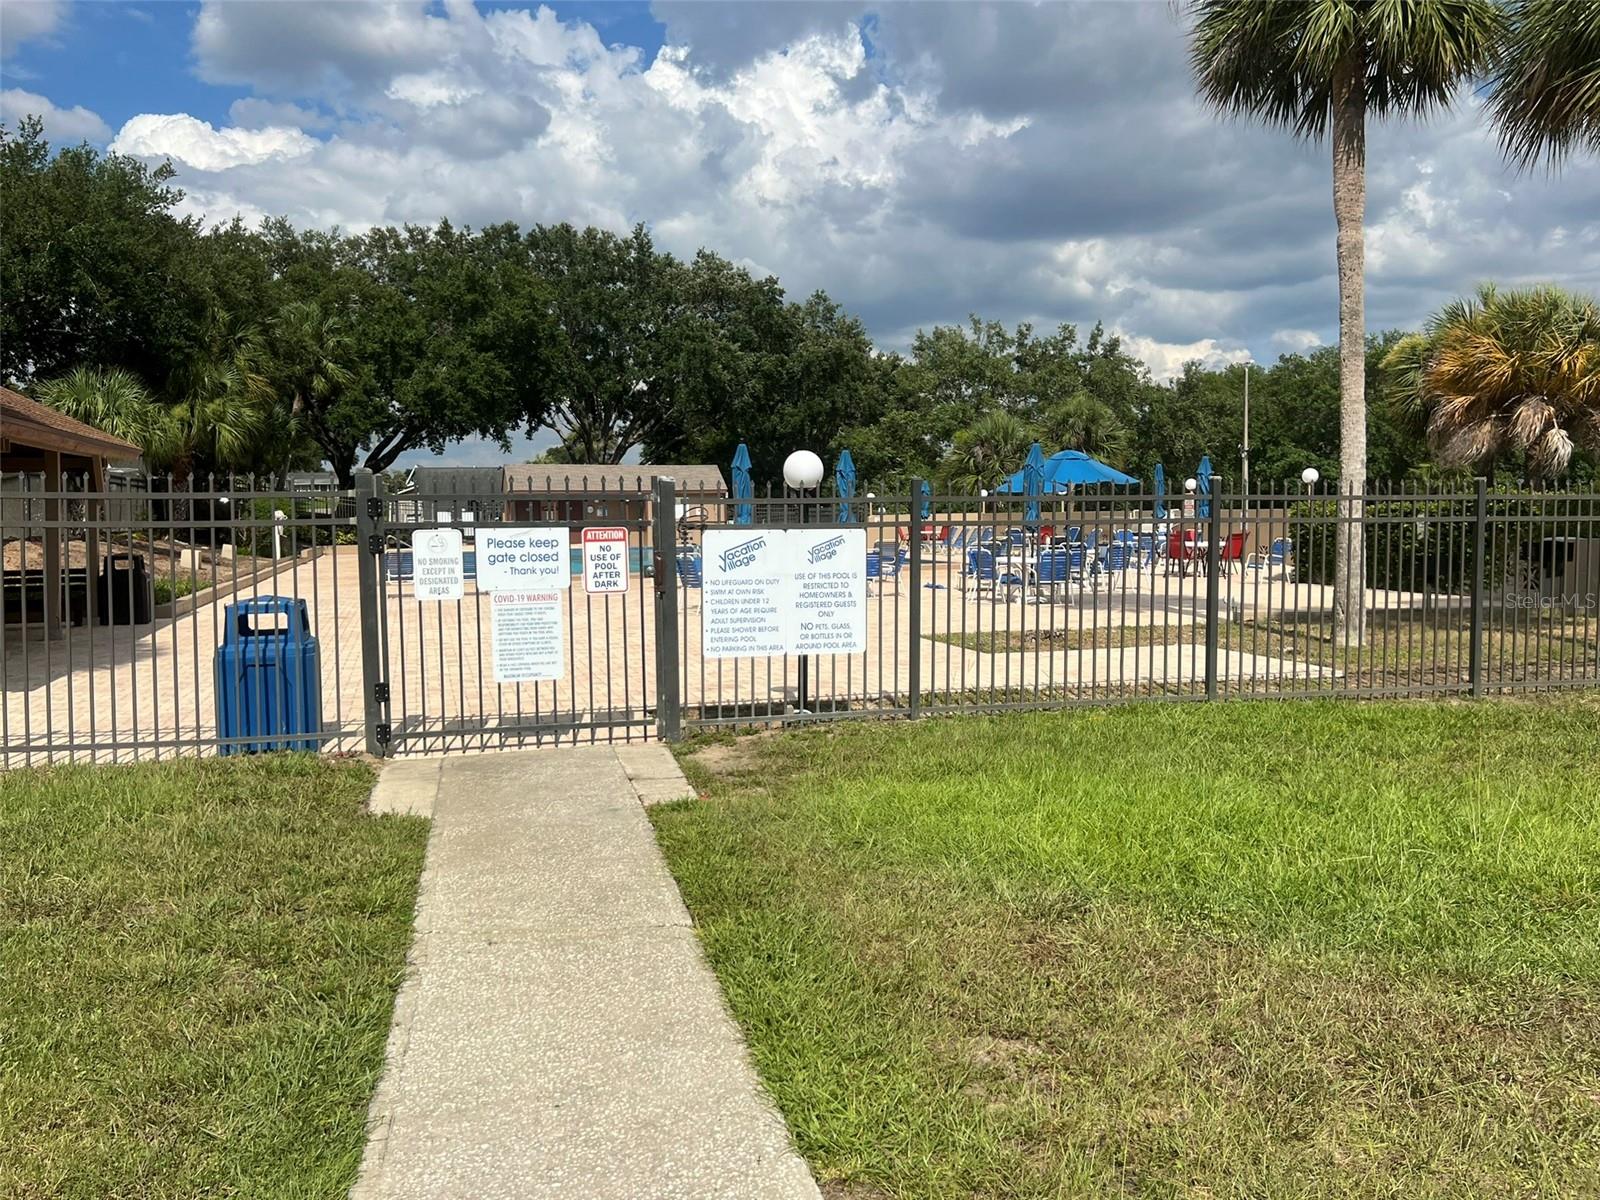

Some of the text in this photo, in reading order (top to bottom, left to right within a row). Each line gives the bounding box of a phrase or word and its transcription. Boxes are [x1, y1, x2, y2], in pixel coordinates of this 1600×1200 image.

[587, 530, 624, 540] ATTENTION
[487, 538, 559, 549] Please keep
[719, 536, 766, 561] Vacation
[808, 535, 845, 557] Vacation
[488, 552, 559, 565] gate closed
[808, 549, 837, 564] Village
[719, 554, 756, 572] Village
[510, 567, 537, 575] Thank
[539, 566, 559, 576] you!
[494, 593, 558, 603] COVID-19 WARNING
[801, 622, 814, 630] NO
